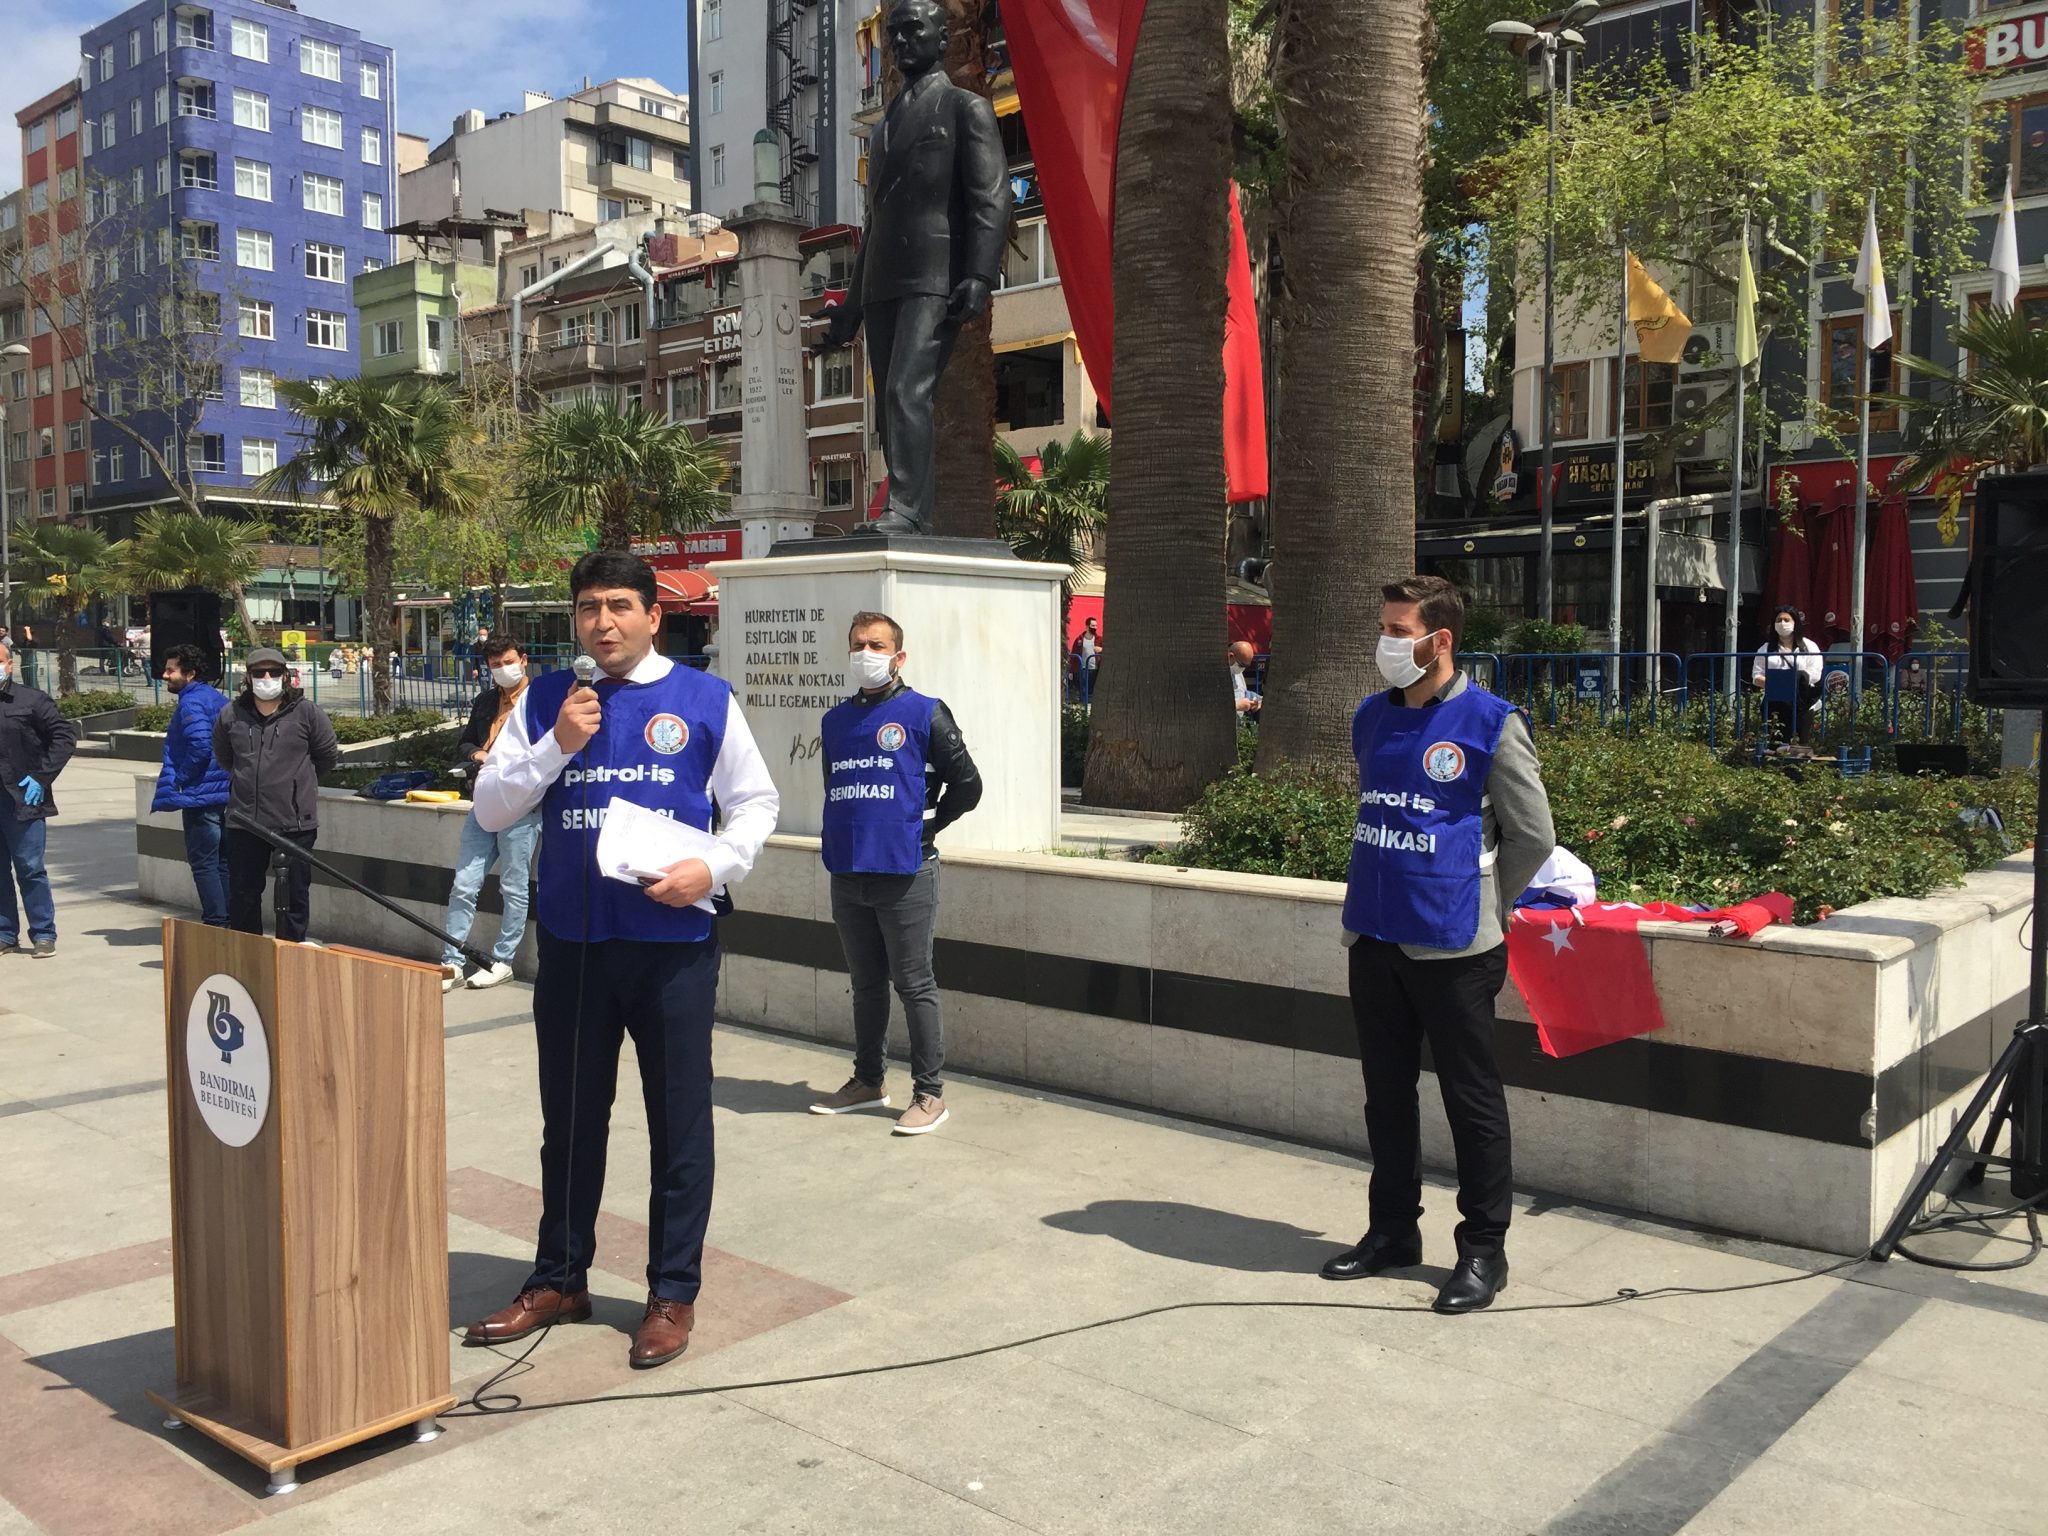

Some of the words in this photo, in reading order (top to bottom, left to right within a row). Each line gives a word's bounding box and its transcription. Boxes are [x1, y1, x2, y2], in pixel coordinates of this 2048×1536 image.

[810, 608, 825, 622] DE
[802, 630, 817, 643] DE
[746, 651, 800, 665] ADALETİN
[804, 651, 818, 664] DE
[746, 672, 794, 686] DAYANAK
[798, 674, 846, 687] NOKTASI
[832, 756, 894, 774] petrol-iş
[565, 764, 675, 787] petrol-iş
[830, 782, 895, 802] SENDİKASI
[1354, 822, 1437, 854] SENDİKASI
[200, 1071, 256, 1101] BANDIRMA
[201, 1089, 257, 1120] BELEDİYESİ
